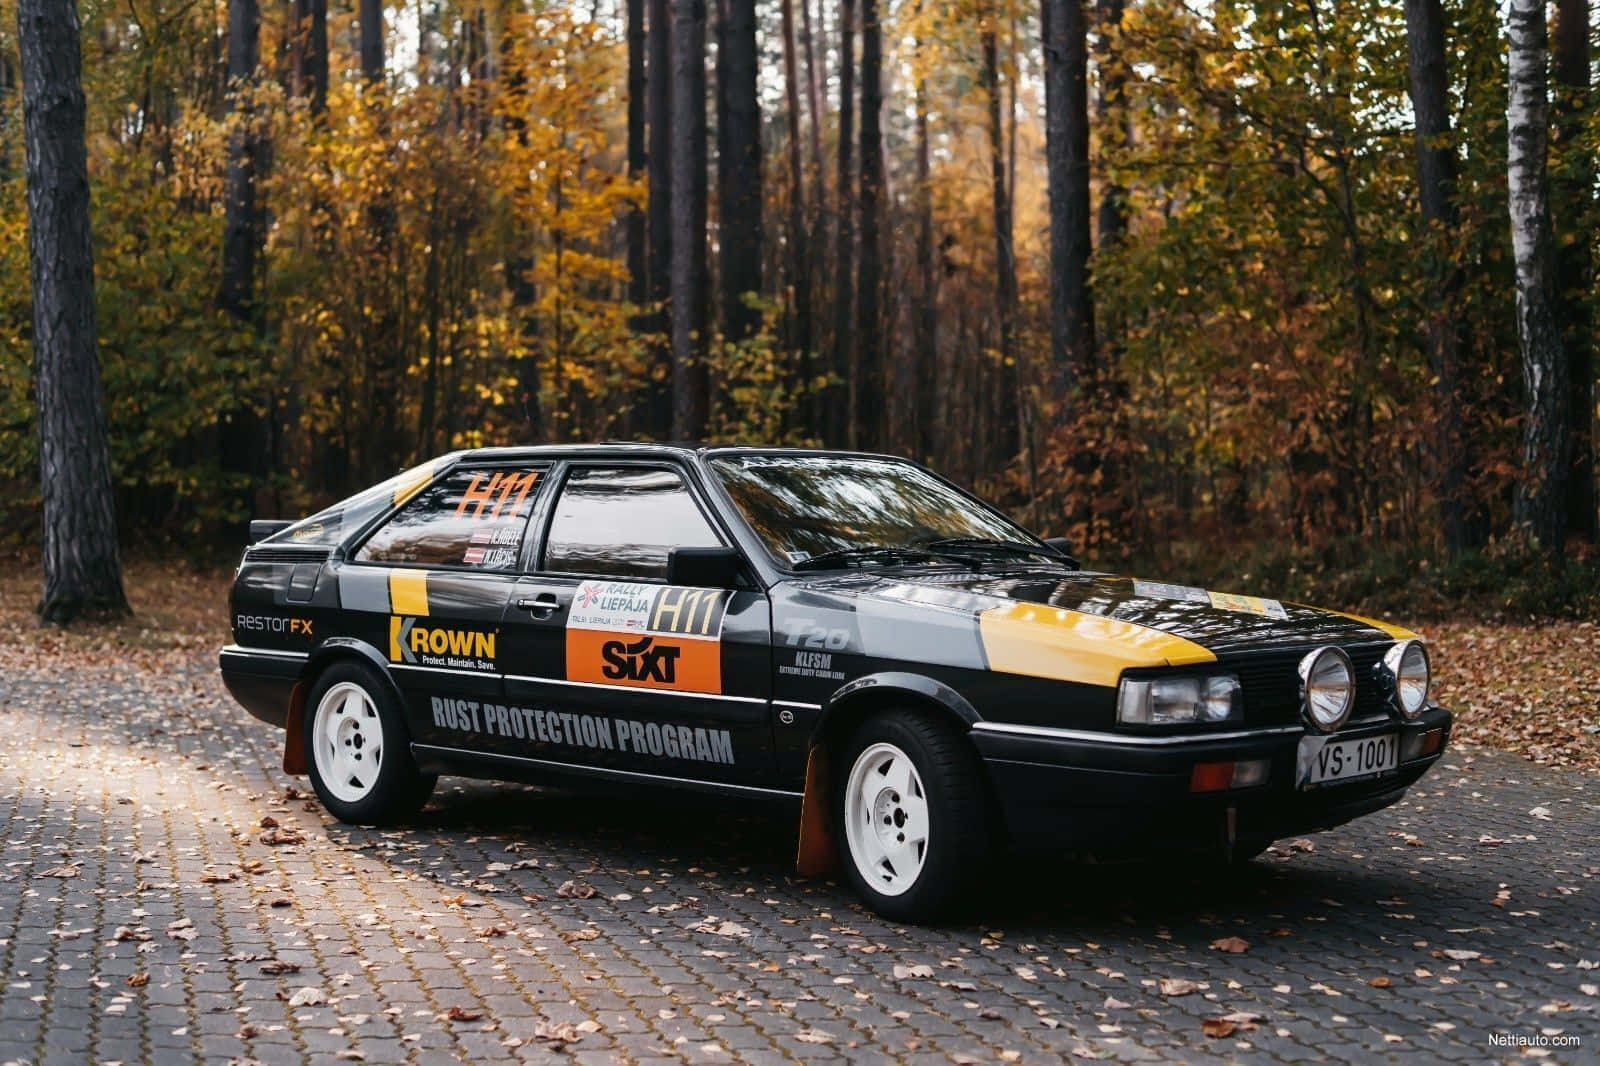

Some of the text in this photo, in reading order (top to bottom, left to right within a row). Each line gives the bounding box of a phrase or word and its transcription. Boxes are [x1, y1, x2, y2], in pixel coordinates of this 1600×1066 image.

[454, 471, 539, 523] H11
[605, 583, 650, 595] RALLY
[652, 588, 721, 635] H11
[783, 617, 851, 650] T20
[794, 650, 832, 670] KLFSM
[431, 696, 736, 765] RUST PROTECTION PROGRAM
